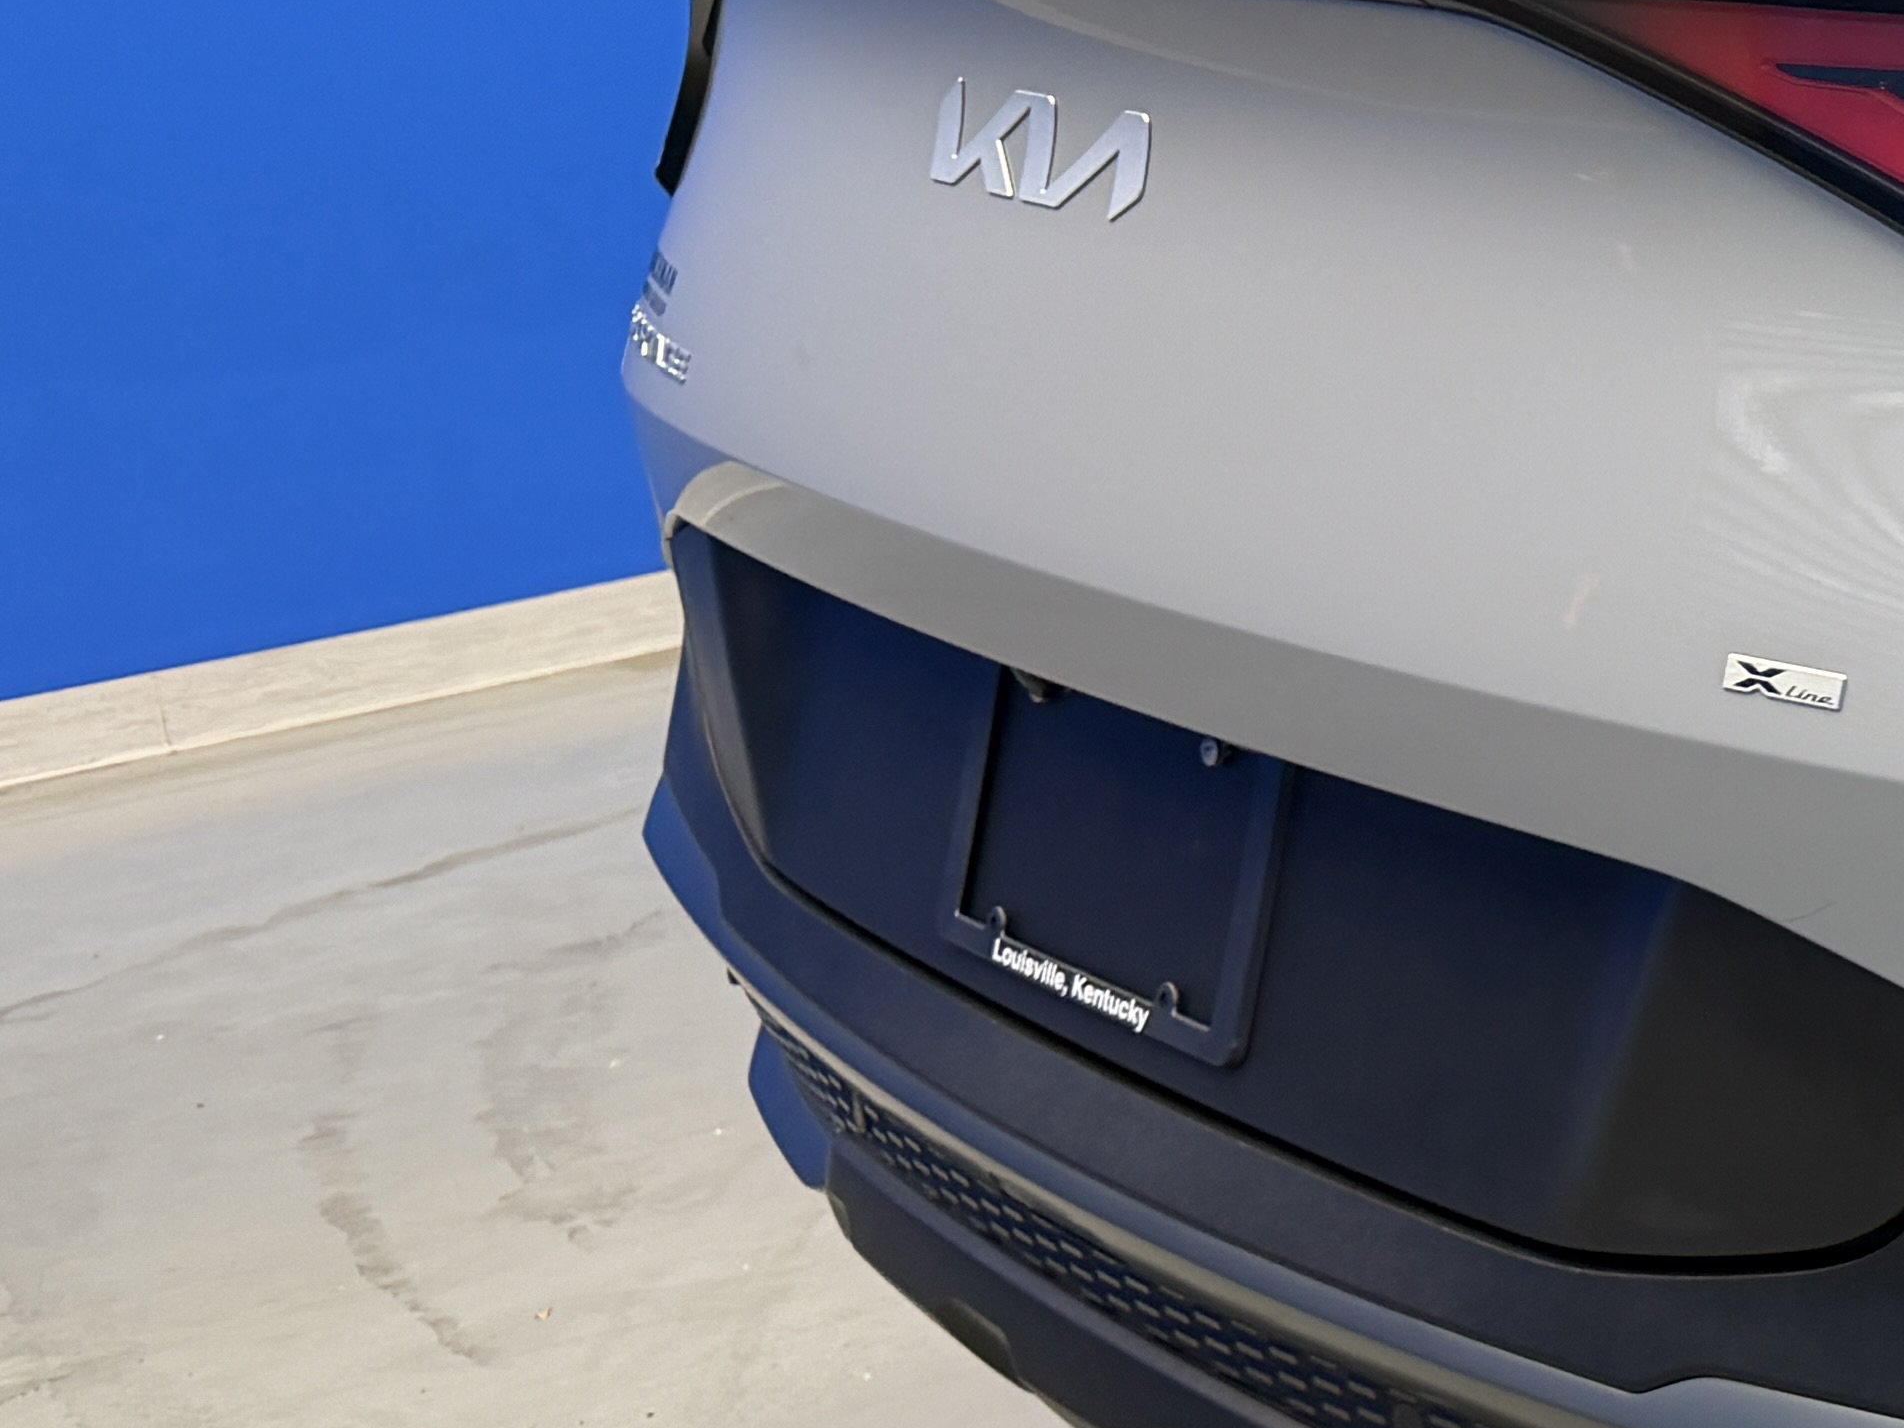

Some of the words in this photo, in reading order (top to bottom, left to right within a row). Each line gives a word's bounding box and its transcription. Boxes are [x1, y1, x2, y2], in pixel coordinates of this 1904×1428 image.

[930, 77, 1152, 222] KIA
[992, 937, 1068, 998] Louisville,
[1071, 974, 1149, 1034] Kentucky
